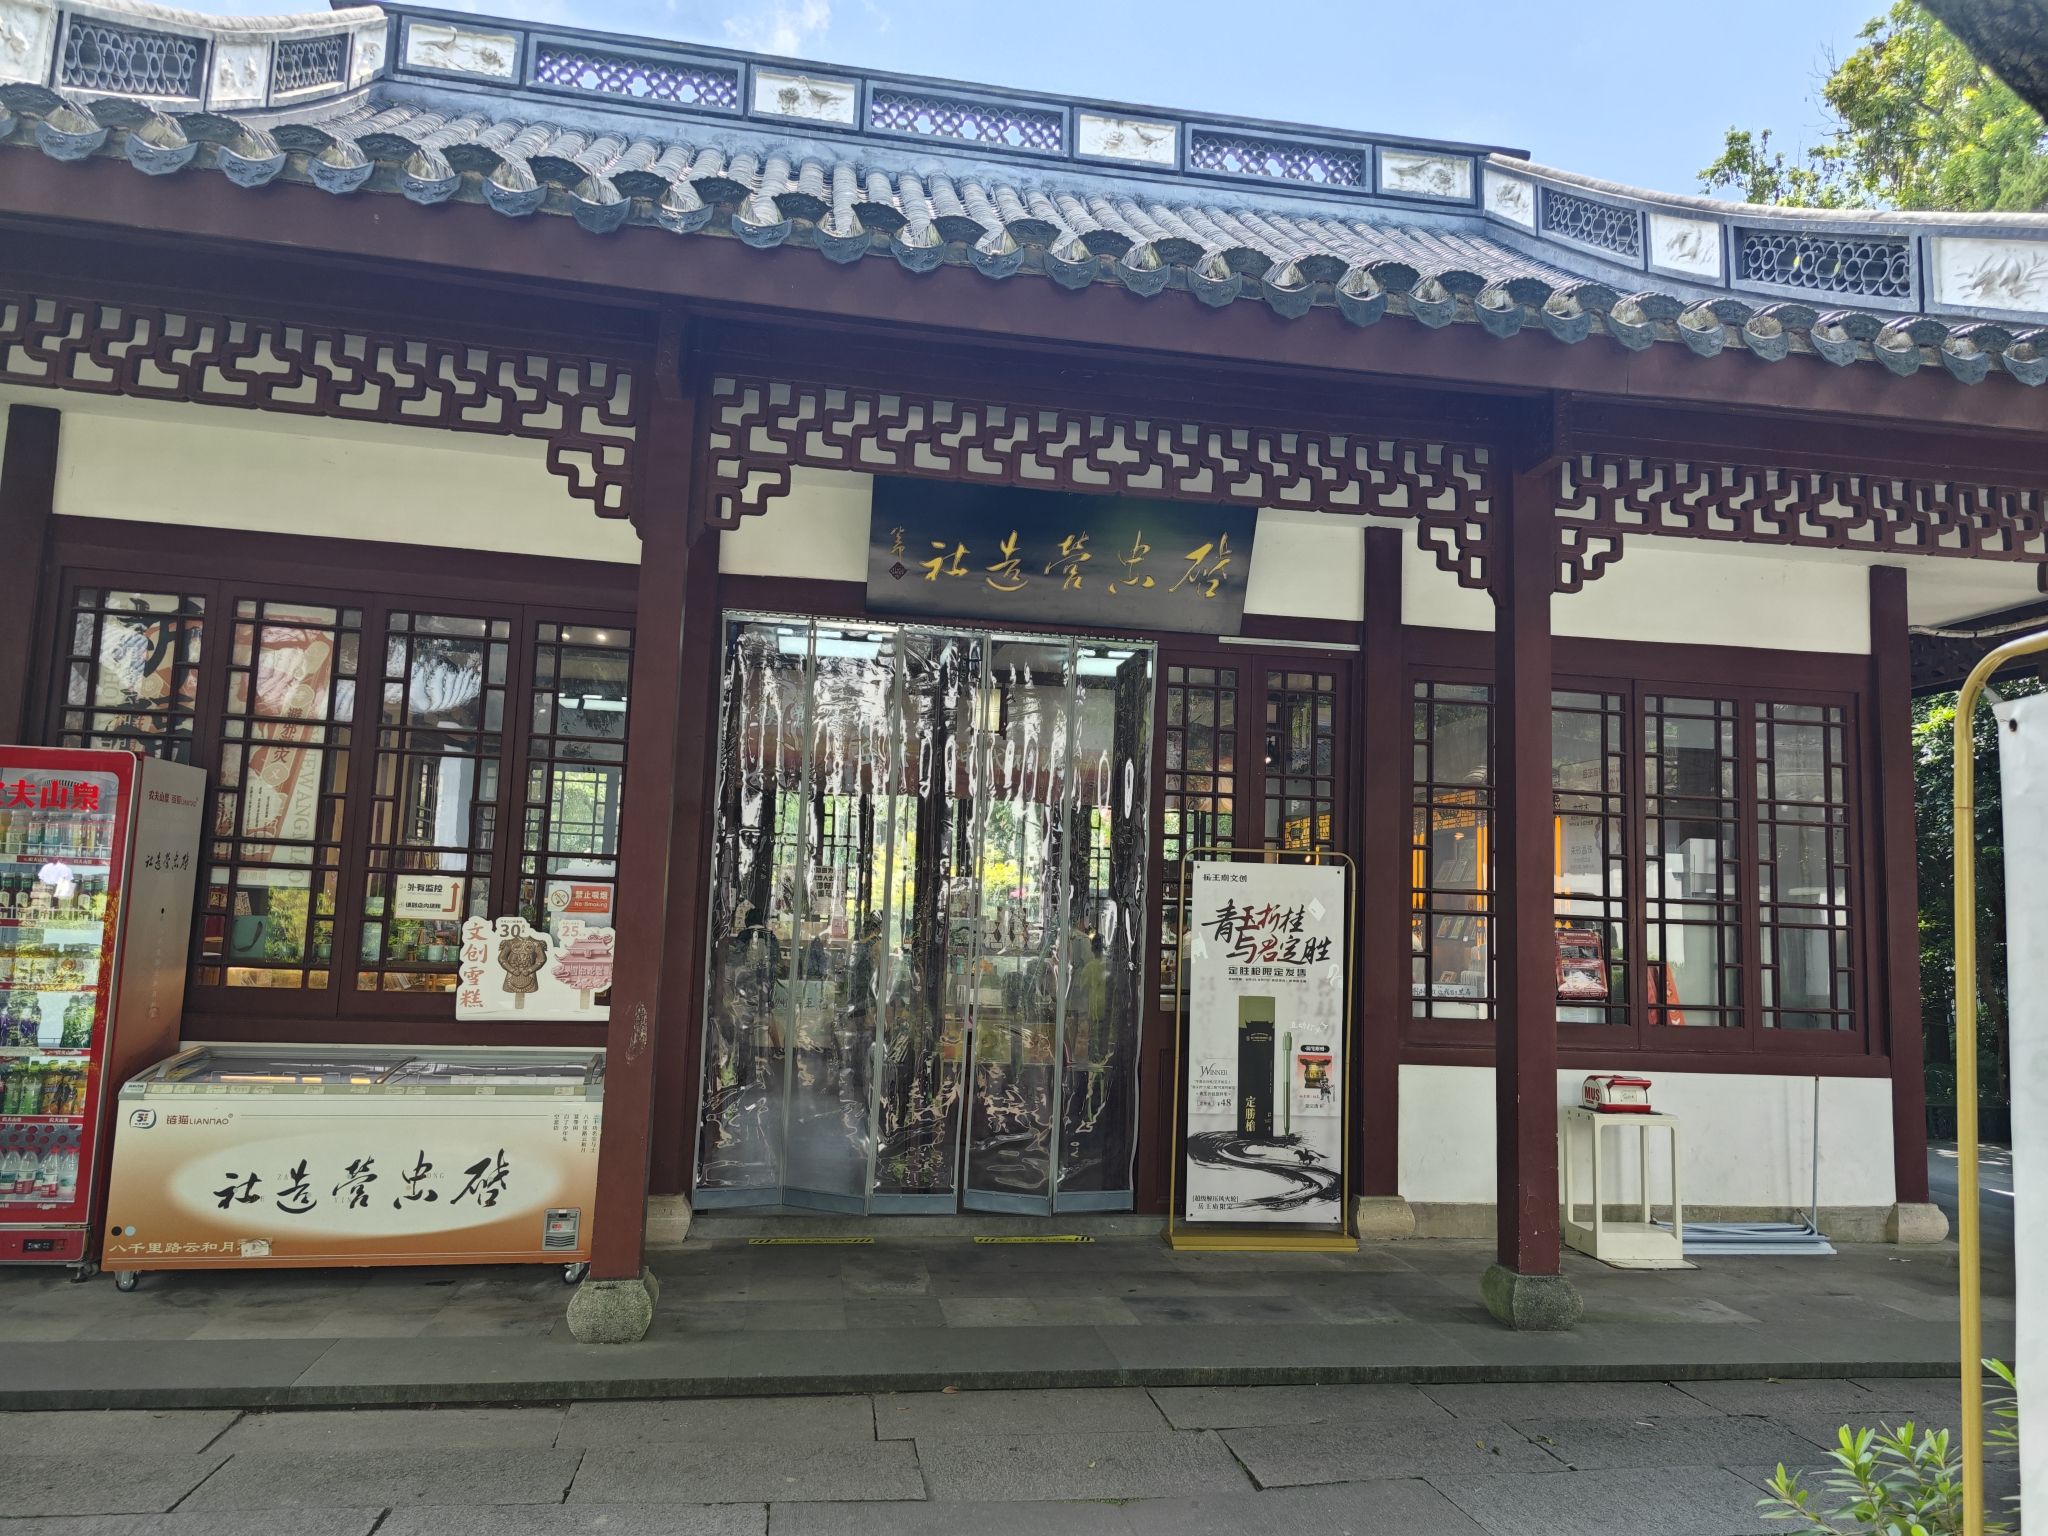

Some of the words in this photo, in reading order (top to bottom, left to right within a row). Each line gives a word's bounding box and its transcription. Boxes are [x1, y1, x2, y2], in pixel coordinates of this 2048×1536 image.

[575, 890, 608, 900] 禁止吸烟
[1201, 898, 1306, 943] 青玉折桂
[500, 924, 521, 938] 30
[562, 925, 579, 937] 25
[1226, 931, 1332, 966] 与君定胜
[459, 922, 488, 1008] 文创雪糕
[109, 1241, 242, 1254] 八千里路云和月
